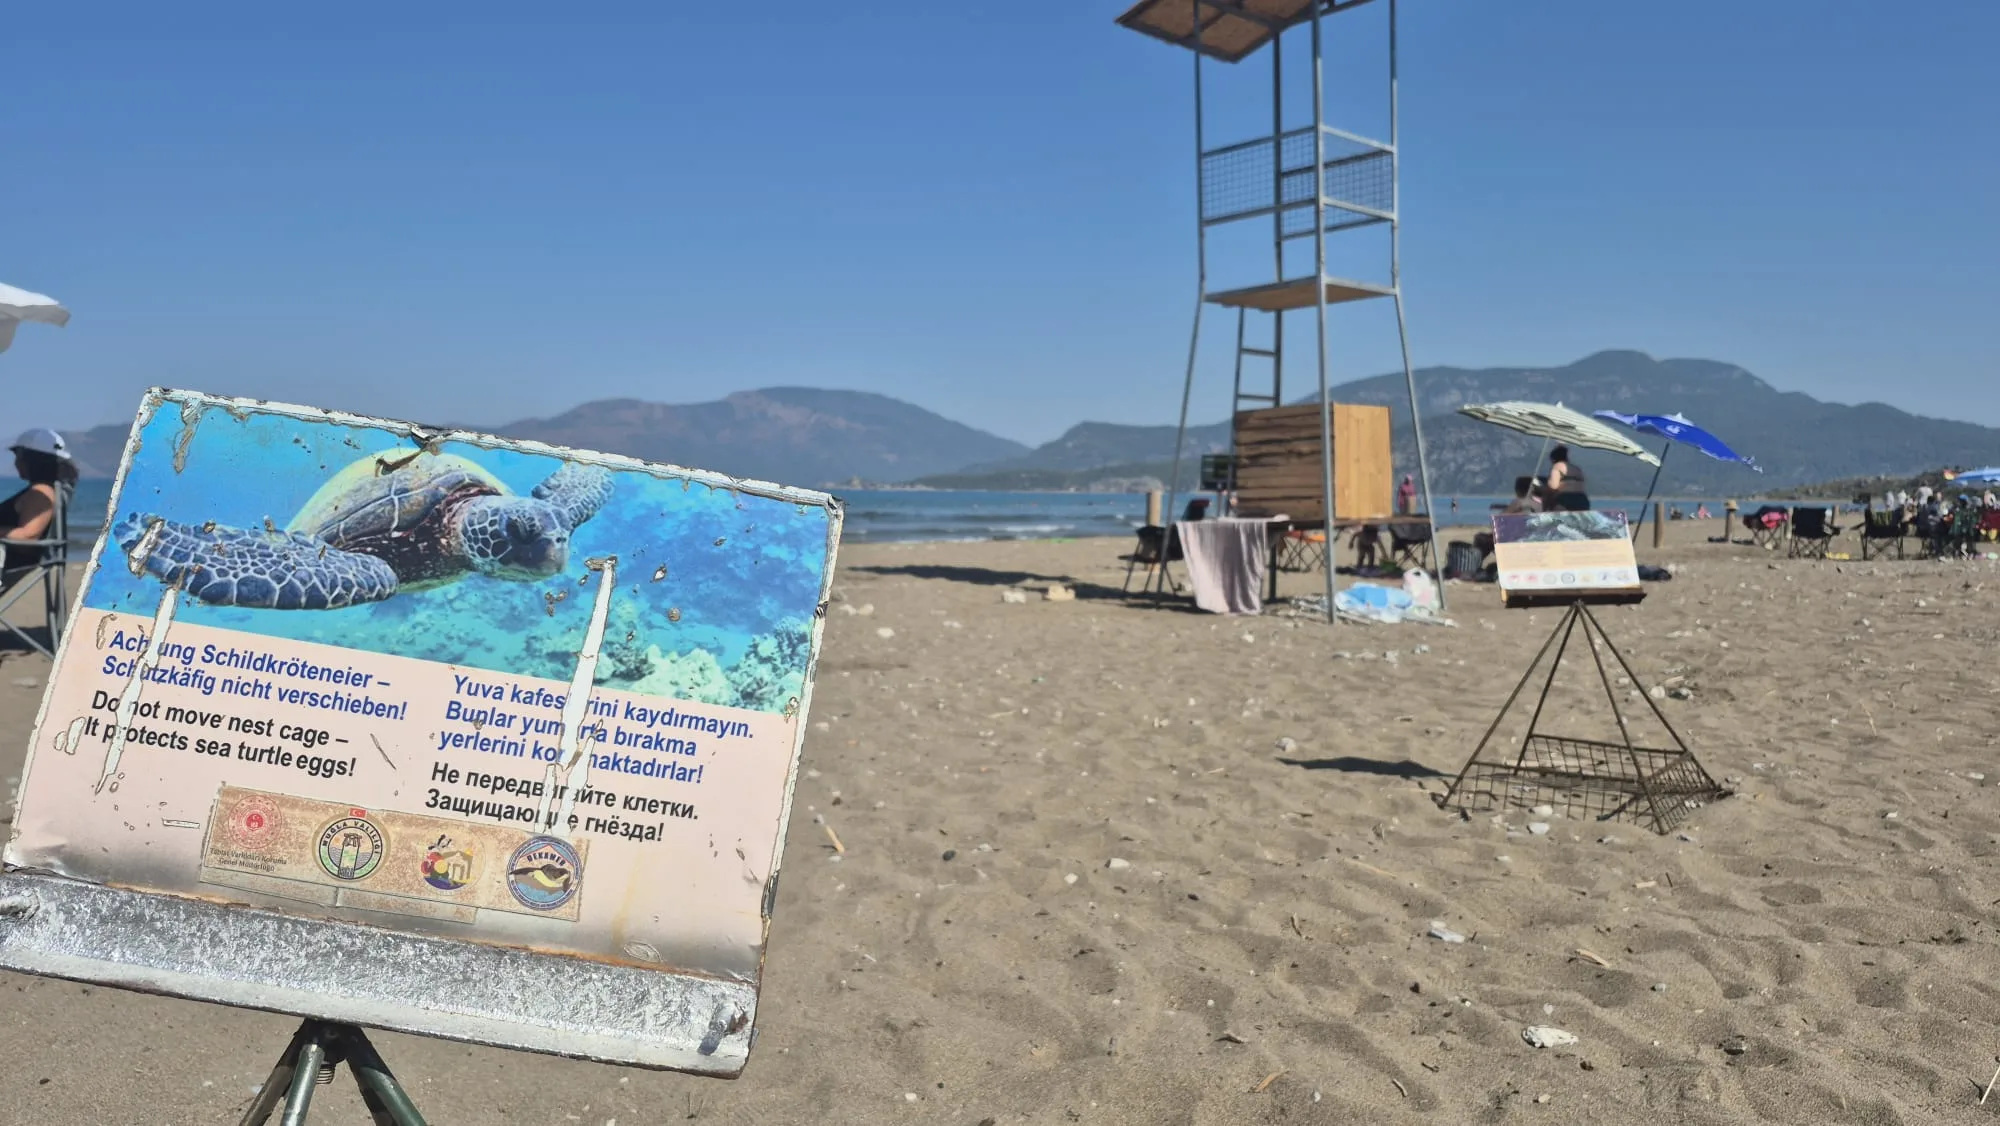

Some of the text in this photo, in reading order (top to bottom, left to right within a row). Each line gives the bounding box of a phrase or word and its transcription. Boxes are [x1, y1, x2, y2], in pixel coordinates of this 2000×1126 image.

[109, 631, 196, 665] Achung
[201, 644, 373, 689] Schildkröteneier
[92, 690, 120, 712] Do
[165, 706, 222, 728] move
[228, 713, 273, 737] nest
[279, 724, 330, 749] cage
[220, 676, 272, 700] nicht
[278, 689, 407, 720] verschieben!
[453, 674, 754, 740] Yuva kafesrini kaydırmayın.
[84, 716, 356, 778] It potects sea turtle eggs!
[438, 729, 525, 758] yerlerini
[446, 700, 697, 756] Bunlar yumrta bırakma
[431, 761, 460, 784] Не
[622, 794, 699, 820] клетки.
[585, 815, 664, 842] гнёзда!
